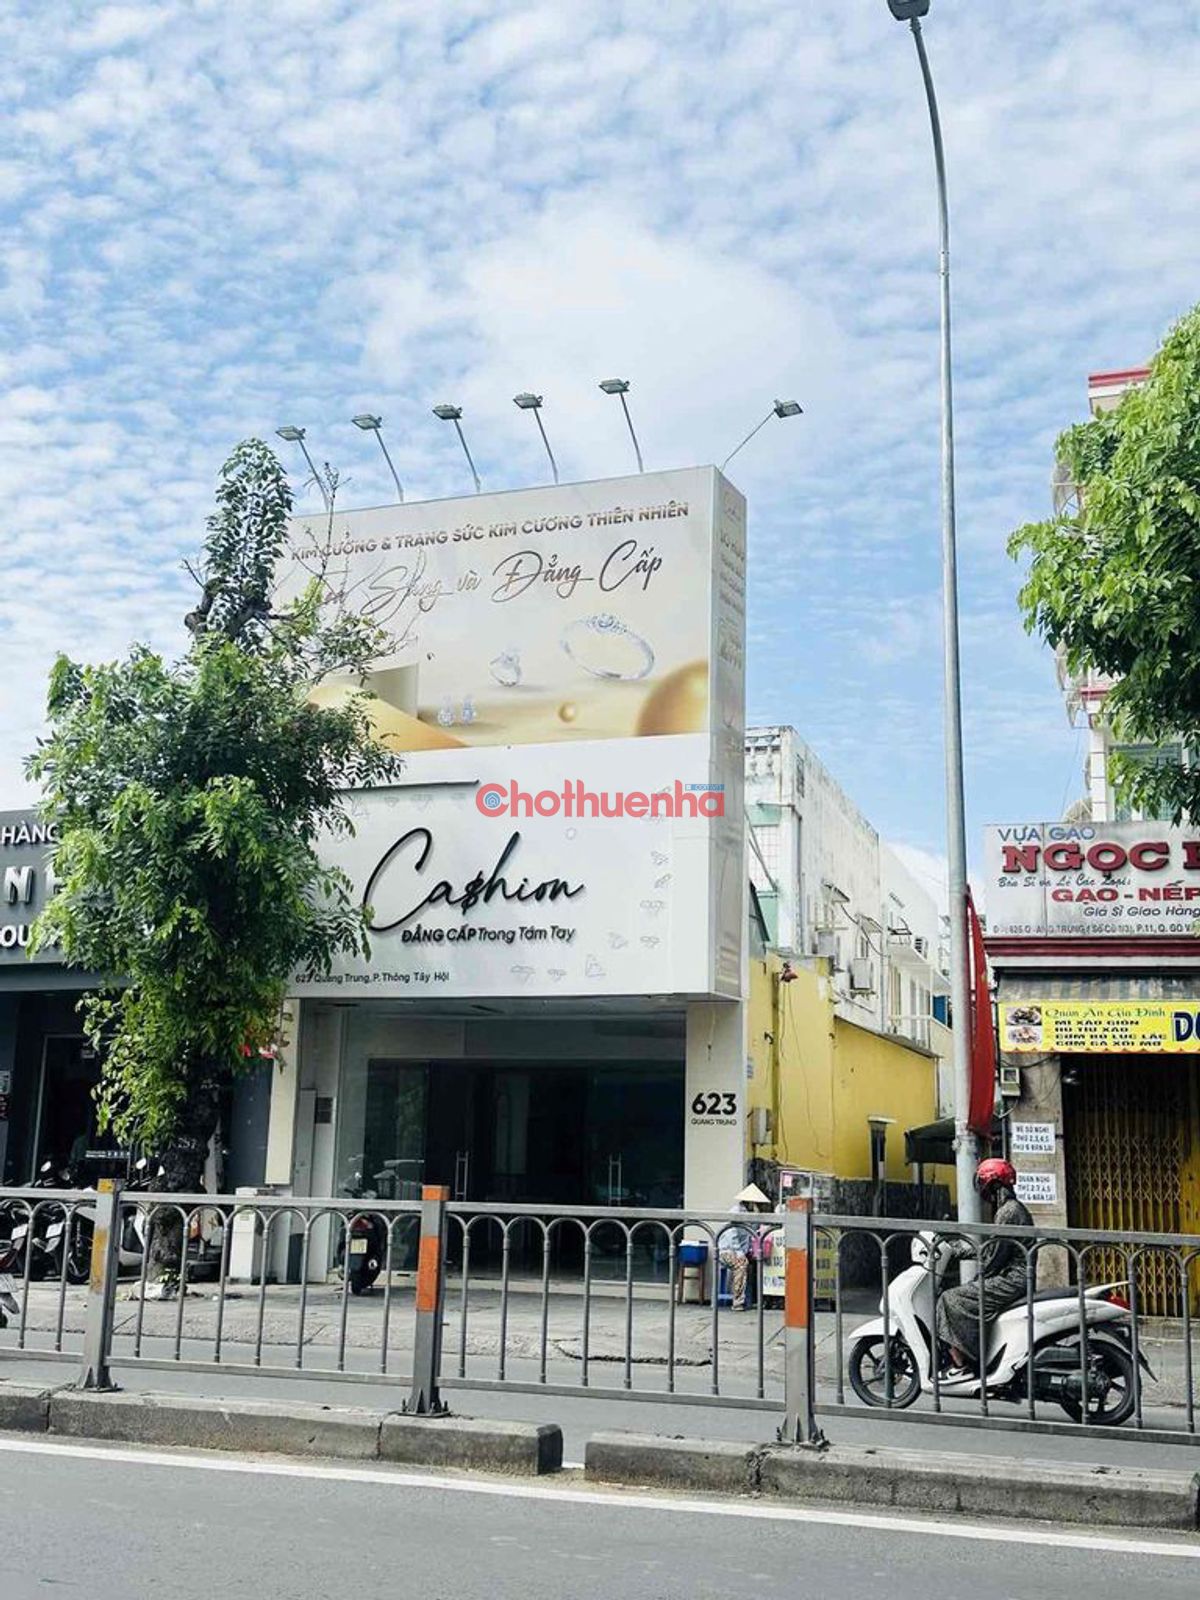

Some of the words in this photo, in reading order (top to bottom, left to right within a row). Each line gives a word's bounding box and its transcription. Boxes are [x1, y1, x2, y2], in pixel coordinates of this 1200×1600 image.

[381, 537, 392, 550] &
[395, 532, 449, 549] TRANG
[452, 524, 485, 543] SỨC
[489, 522, 518, 539] KIM
[521, 515, 584, 535] CƯƠNG
[587, 507, 635, 528] THIÊN
[638, 500, 690, 522] NHIÊN
[456, 569, 482, 592] và
[491, 550, 595, 603] Đẳng
[599, 539, 663, 592] Cấp
[998, 825, 1042, 845] VỰA
[1001, 840, 1171, 881] NGỌC
[1051, 887, 1119, 905] GẠO
[1138, 880, 1200, 902] NẾP
[1127, 905, 1161, 917] Giao
[1165, 903, 1200, 919] Hàng
[401, 926, 444, 944] ĐẲNG
[446, 925, 478, 942] CẤP
[478, 928, 516, 945] Trong
[550, 925, 576, 944] Tay
[1172, 1011, 1200, 1042] D
[692, 1092, 737, 1115] 623
[691, 1118, 714, 1126] QUANG
